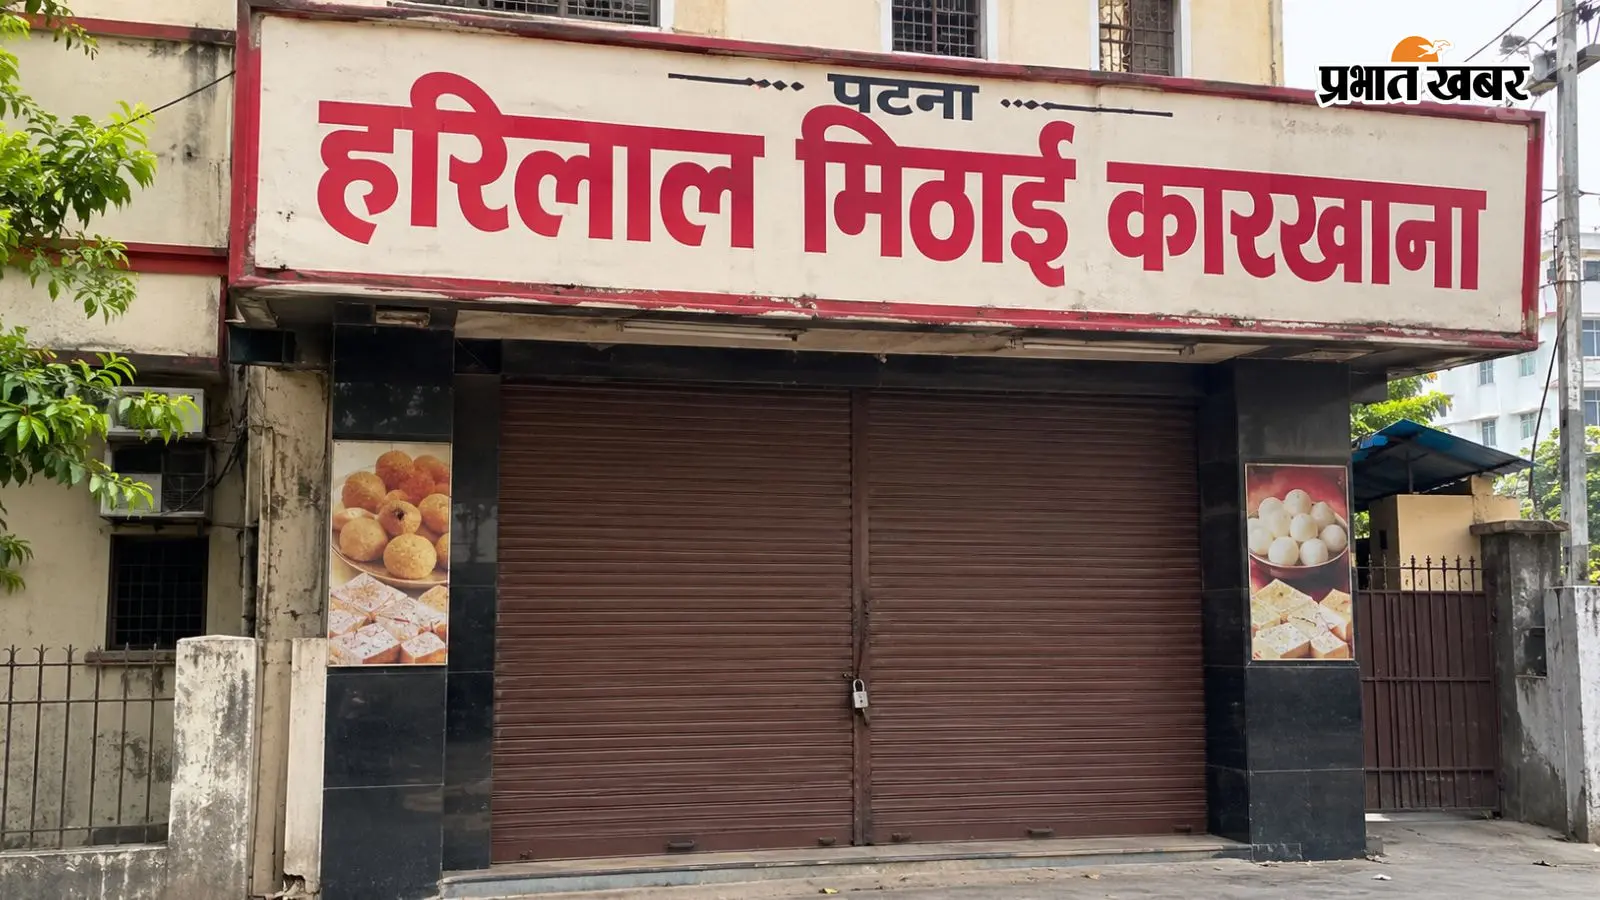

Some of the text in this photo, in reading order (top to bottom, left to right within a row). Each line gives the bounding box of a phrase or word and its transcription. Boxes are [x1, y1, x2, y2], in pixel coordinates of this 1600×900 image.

[828, 74, 979, 121] पटना
[317, 71, 1487, 290] हरिलाल मिठाई कारखाना
